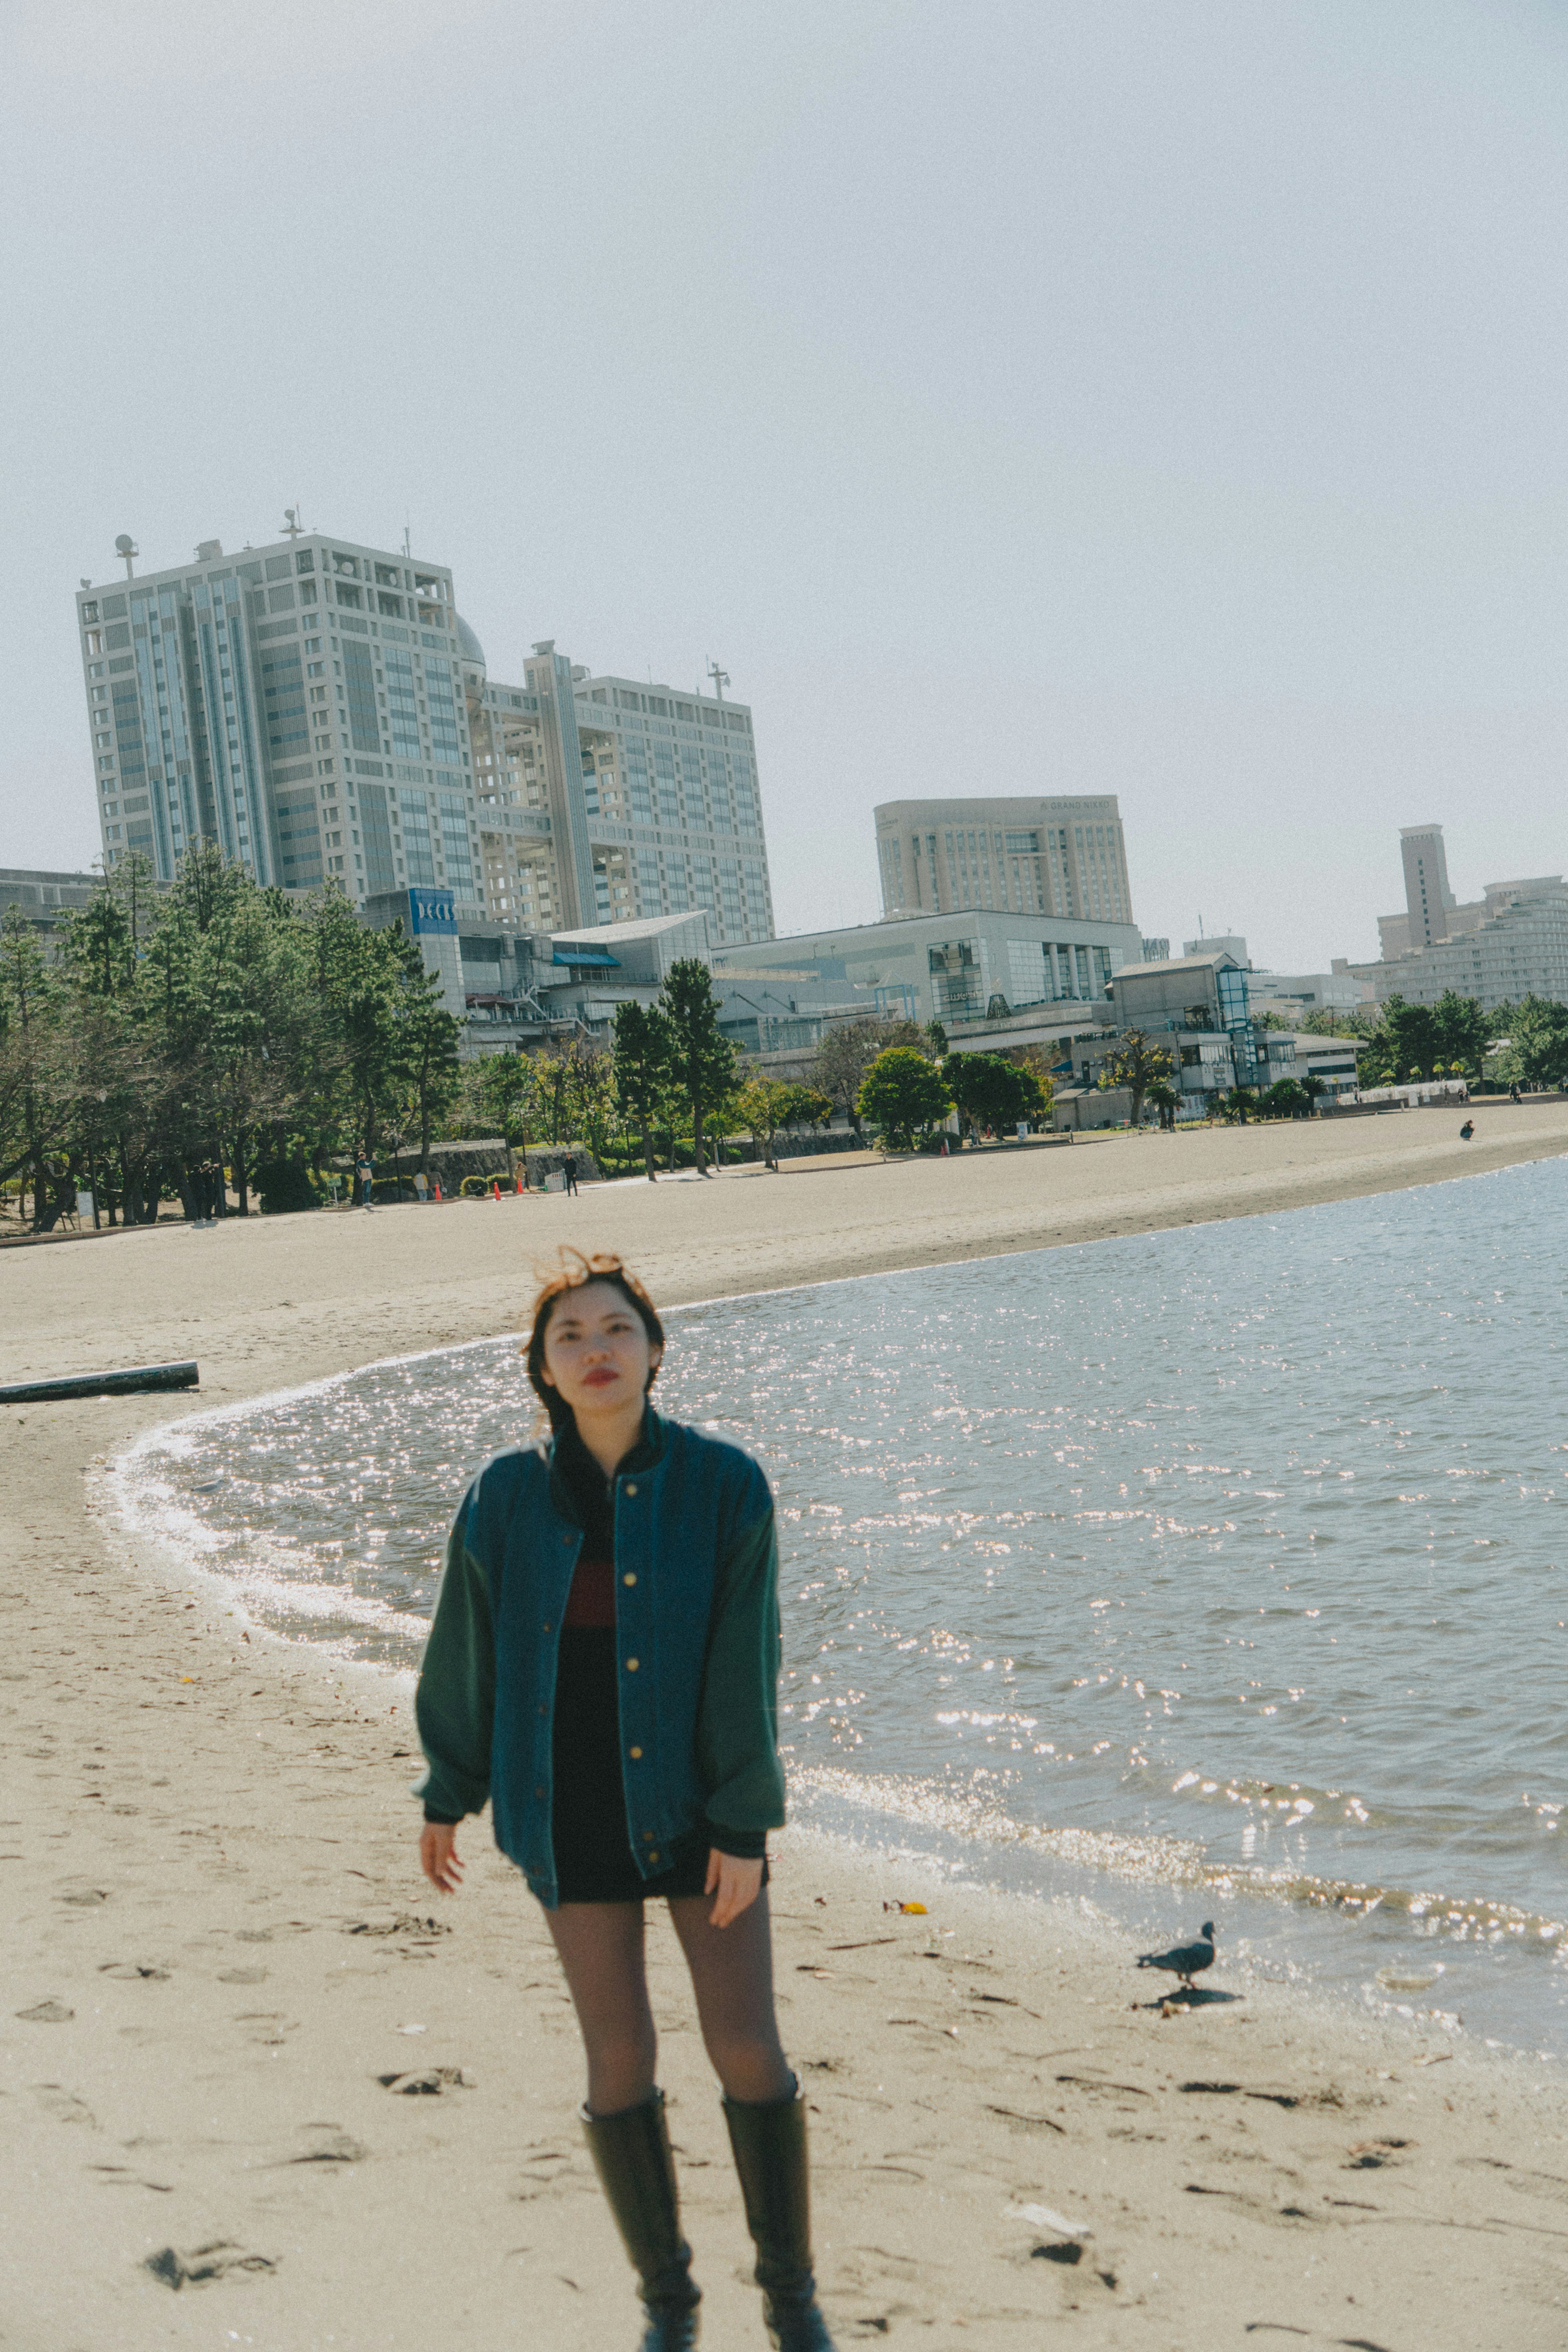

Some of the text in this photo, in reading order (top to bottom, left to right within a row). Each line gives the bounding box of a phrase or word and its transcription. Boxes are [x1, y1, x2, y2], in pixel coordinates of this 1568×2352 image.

[1050, 800, 1109, 809] GRAND NIKKO
[418, 902, 458, 920] DECKS
